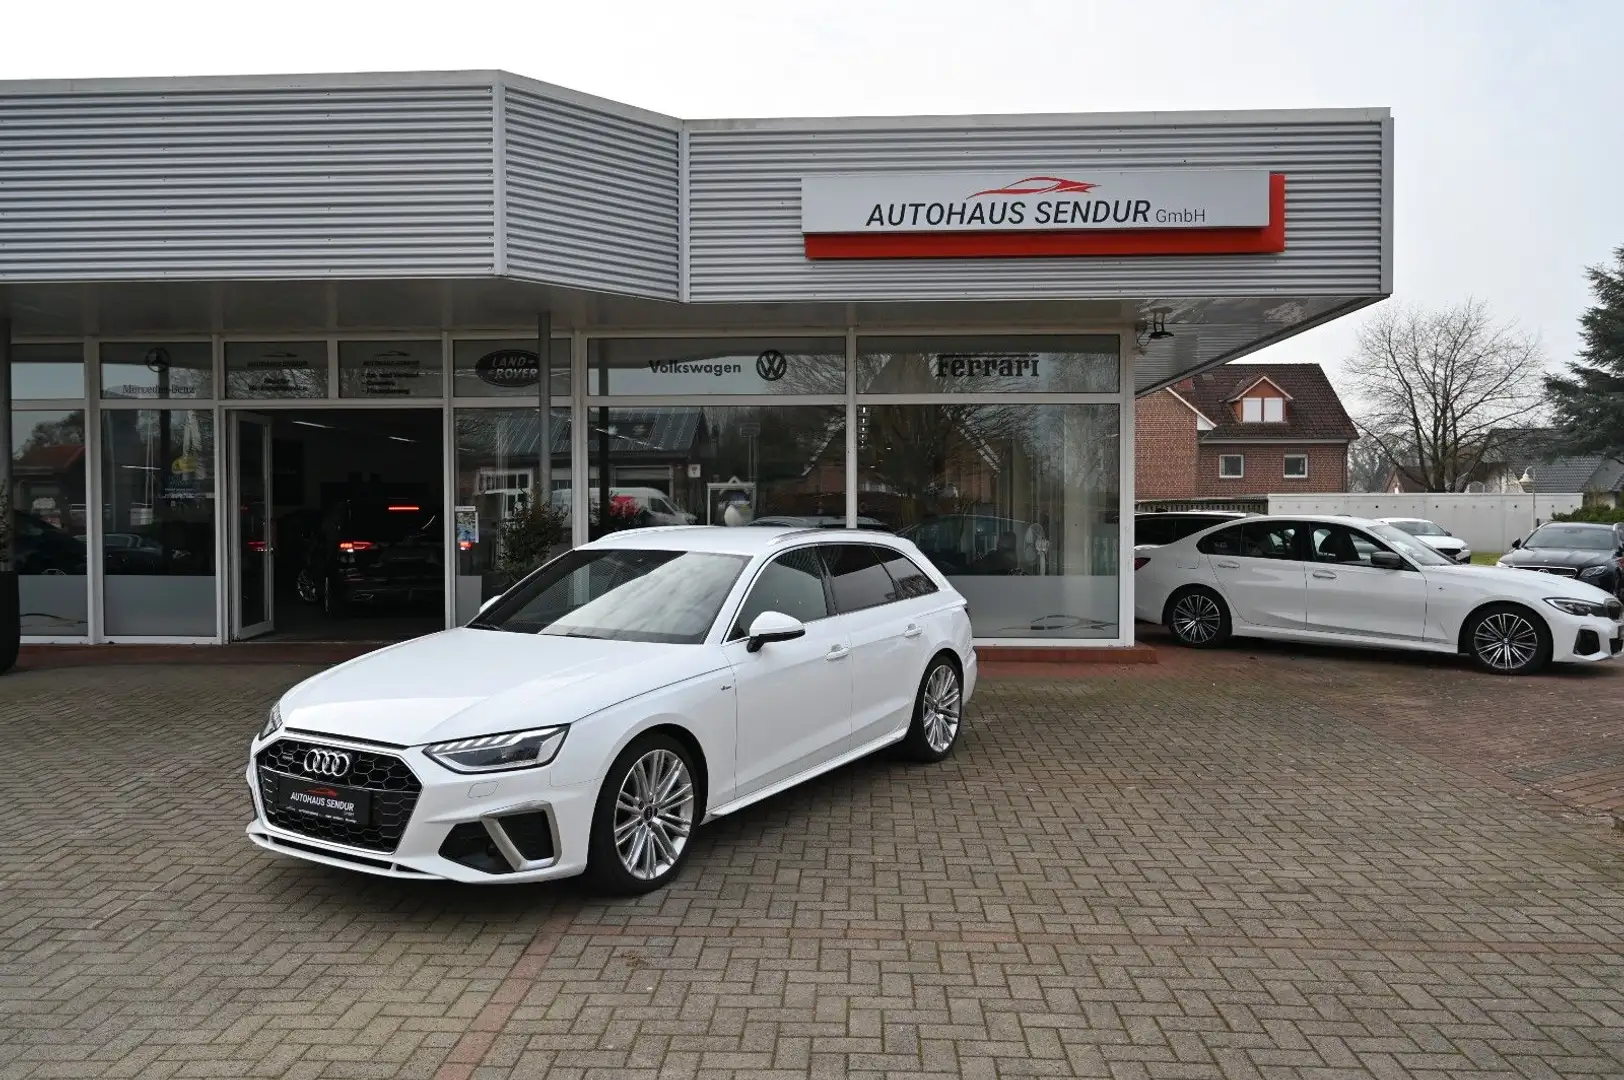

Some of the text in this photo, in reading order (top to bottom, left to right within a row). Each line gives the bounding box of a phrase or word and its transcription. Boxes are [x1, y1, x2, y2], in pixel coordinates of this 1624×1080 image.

[866, 200, 1206, 226] AUTOHAUS SENDUR GmbH
[492, 356, 527, 368] LAND
[648, 359, 742, 376] Volkswagen
[936, 353, 1040, 377] Ferrari
[494, 368, 539, 379] ROVER
[290, 791, 355, 812] AUTOHAUS SENDUR
